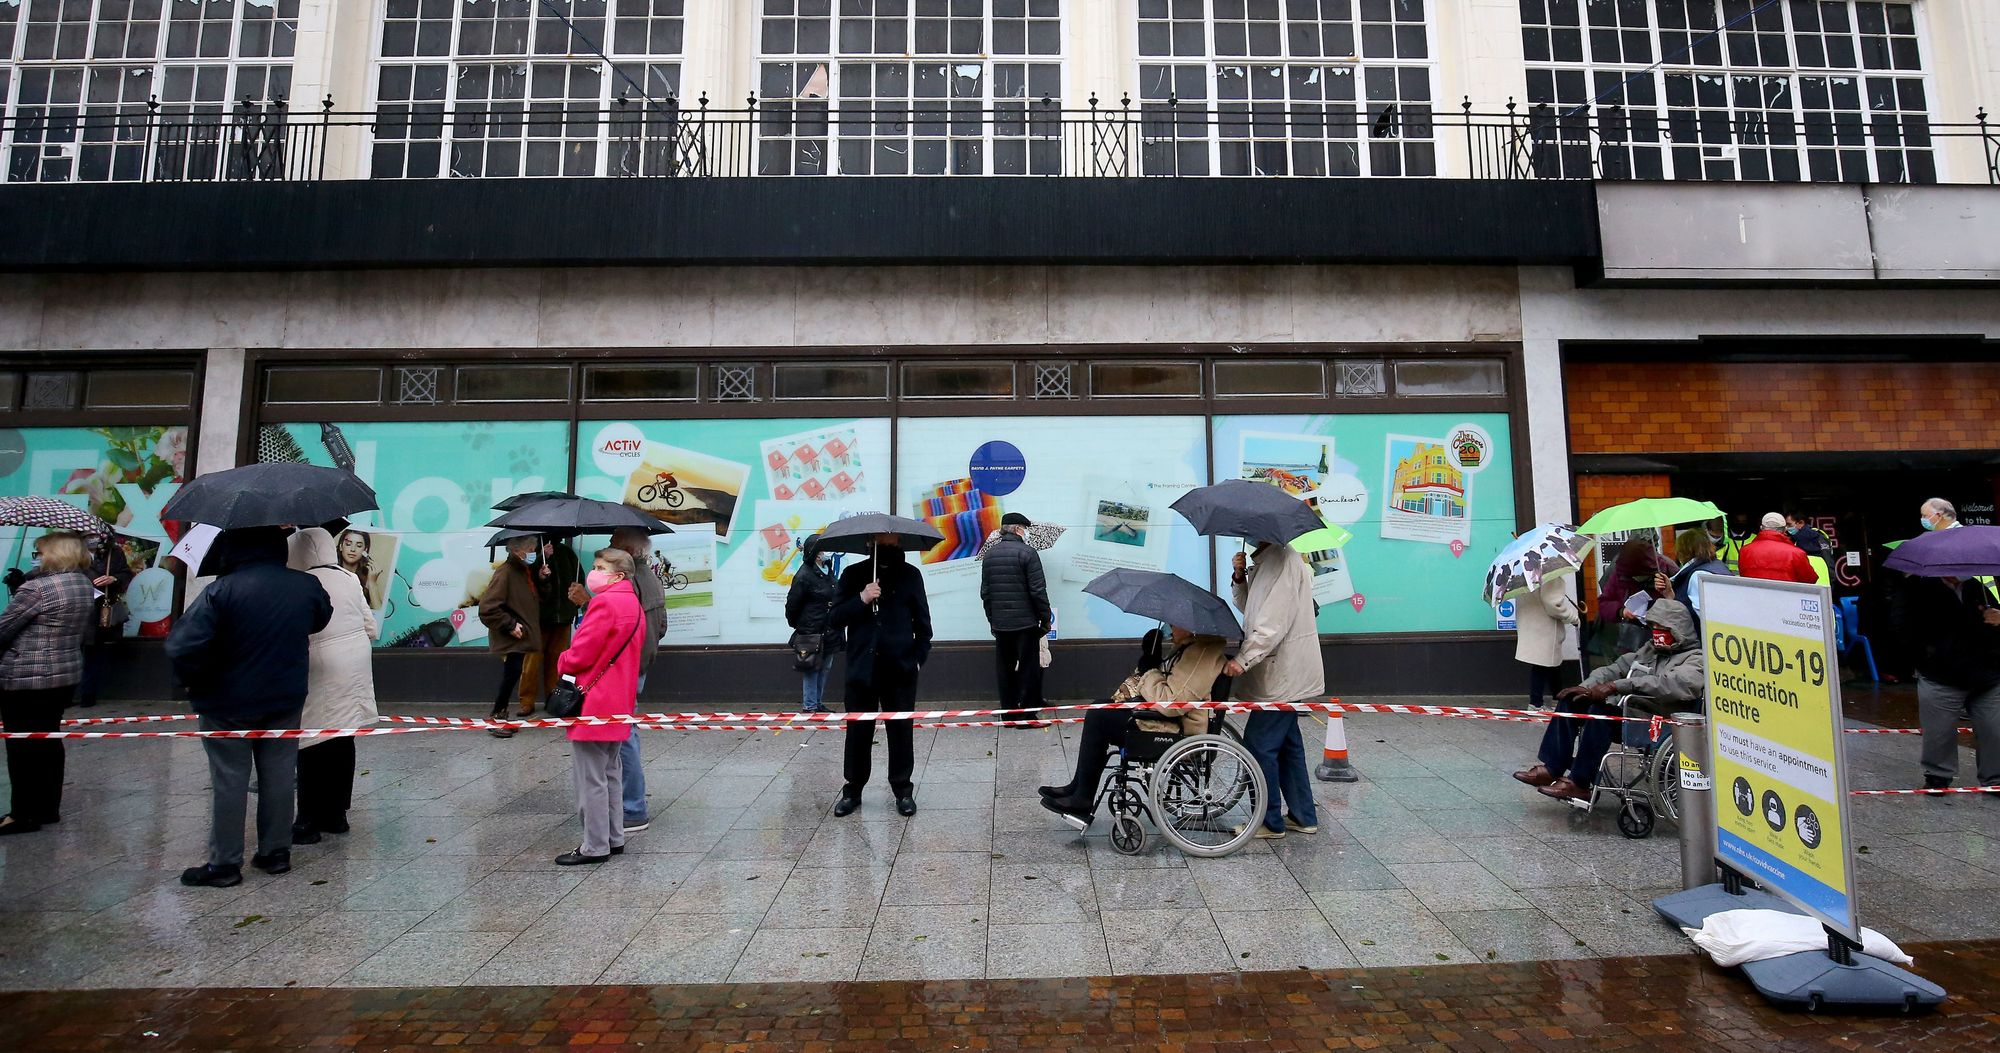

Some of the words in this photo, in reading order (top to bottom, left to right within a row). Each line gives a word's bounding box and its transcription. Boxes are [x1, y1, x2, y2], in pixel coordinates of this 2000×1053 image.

[1460, 446, 1476, 454] 20
[1976, 516, 1991, 525] the
[1451, 543, 1462, 551] 16
[1353, 597, 1363, 605] 15
[1801, 599, 1819, 612] NHS
[453, 614, 463, 622] 10
[1800, 613, 1820, 623] COVID-19
[1782, 619, 1806, 628] Vaccination
[1807, 622, 1822, 630] Centre
[1711, 632, 1825, 687] COVID-19
[1713, 670, 1799, 709] vaccination
[1715, 695, 1760, 724] centre
[1719, 728, 1732, 741] You
[1732, 734, 1749, 748] must
[1750, 740, 1767, 754] have
[1768, 748, 1777, 758] an
[1779, 751, 1828, 778] appointment
[1719, 743, 1727, 752] to
[1728, 746, 1739, 757] use
[1740, 750, 1752, 762] this
[1753, 757, 1779, 773] service.
